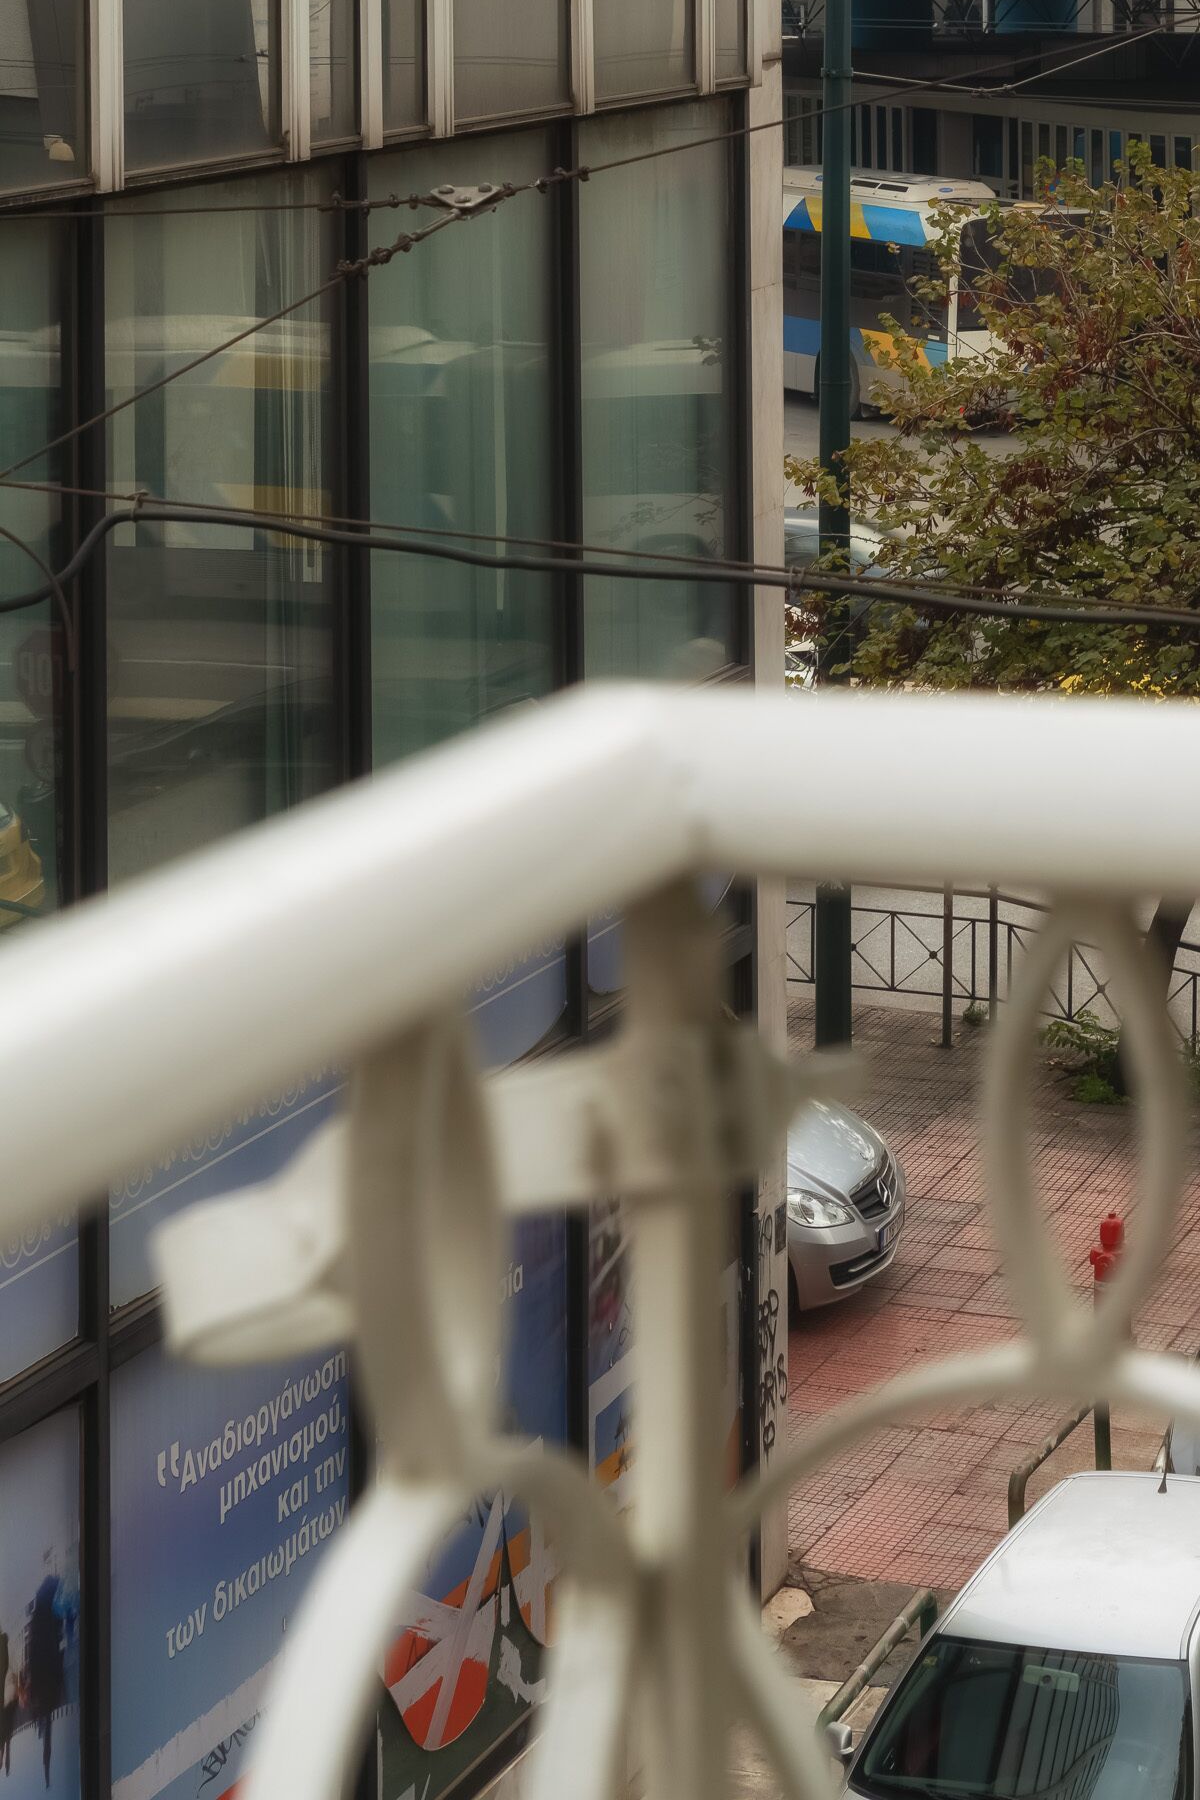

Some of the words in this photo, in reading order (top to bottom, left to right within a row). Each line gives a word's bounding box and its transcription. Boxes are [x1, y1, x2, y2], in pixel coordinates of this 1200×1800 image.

[277, 1478, 309, 1524] και
[315, 1447, 346, 1494] την
[165, 1602, 208, 1661] των
